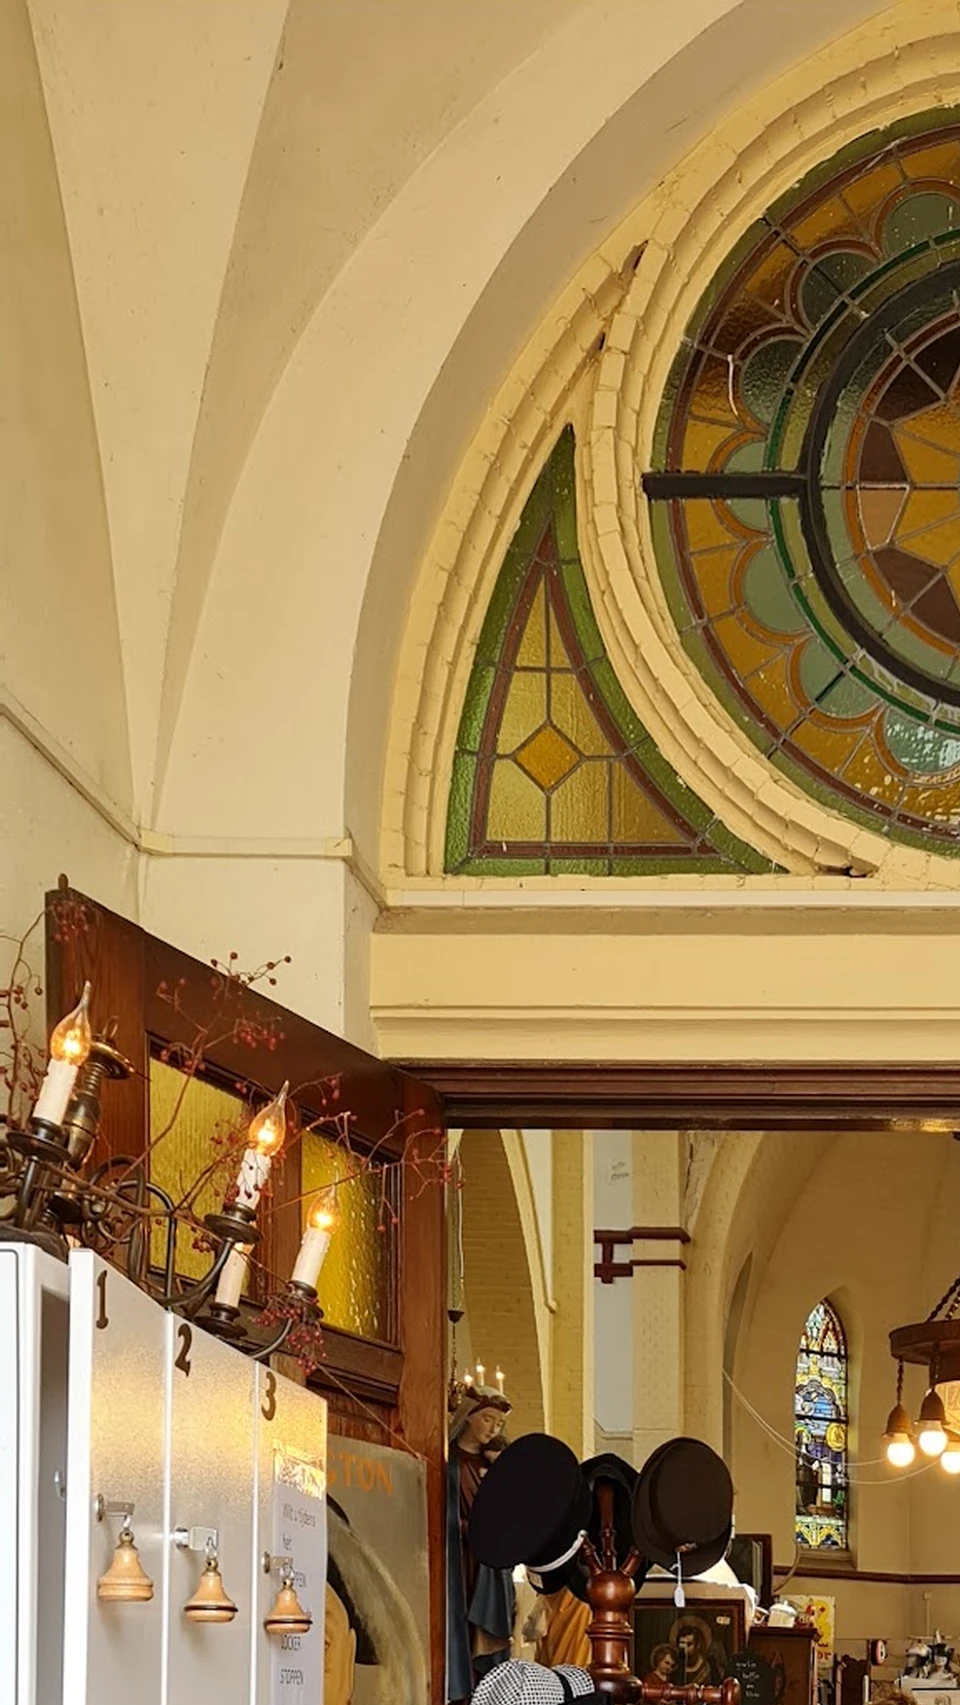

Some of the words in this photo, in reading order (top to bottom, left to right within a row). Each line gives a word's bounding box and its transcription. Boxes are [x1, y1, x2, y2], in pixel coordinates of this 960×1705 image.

[96, 1269, 109, 1330] 1
[174, 1323, 193, 1377] 2
[261, 1371, 277, 1421] 3
